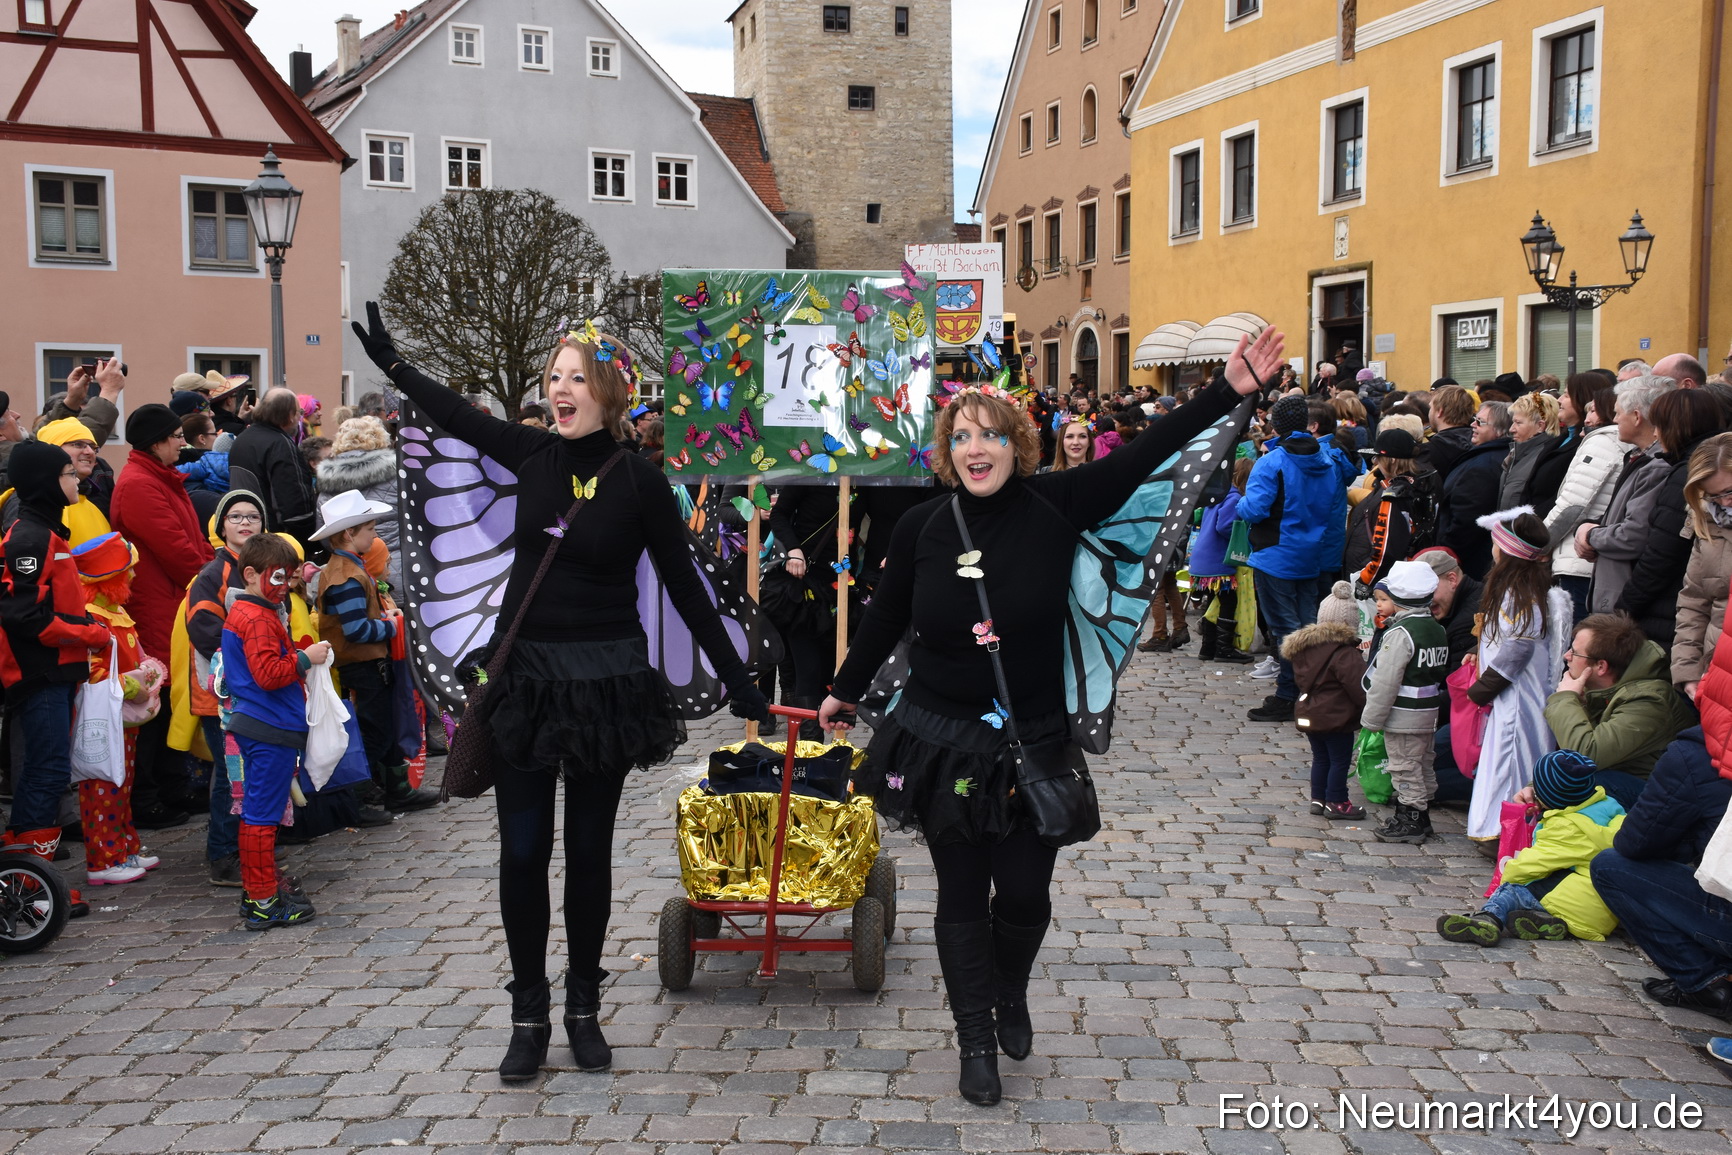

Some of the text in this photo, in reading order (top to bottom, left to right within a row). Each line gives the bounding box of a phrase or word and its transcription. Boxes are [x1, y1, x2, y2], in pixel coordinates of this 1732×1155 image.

[929, 244, 996, 256] Mühlhausen
[990, 320, 1002, 332] 19
[1458, 318, 1488, 337] BW
[777, 343, 826, 391] 18
